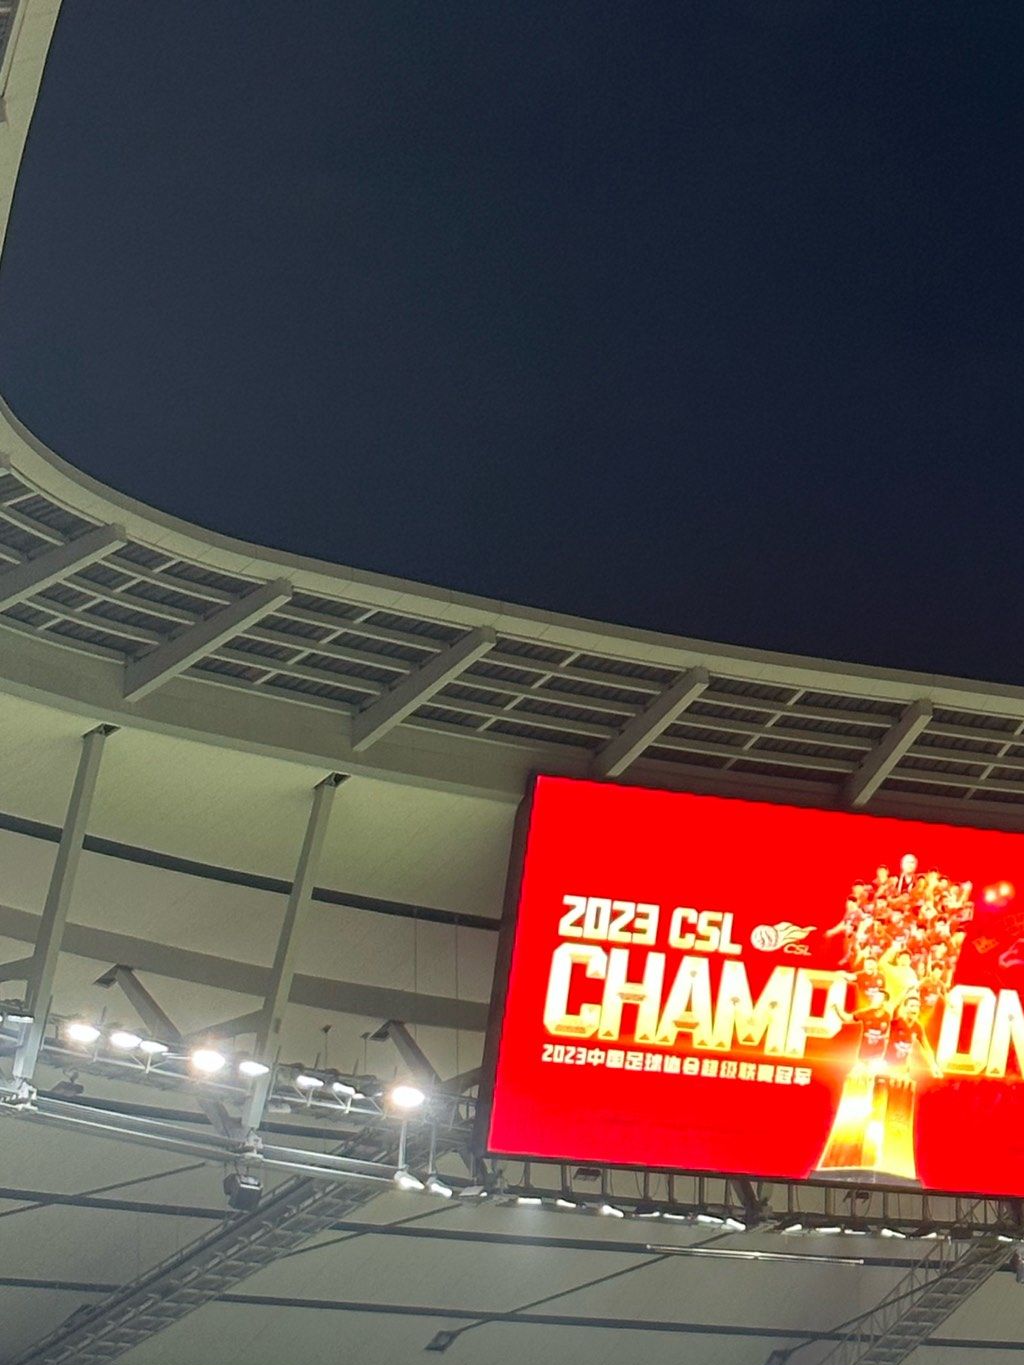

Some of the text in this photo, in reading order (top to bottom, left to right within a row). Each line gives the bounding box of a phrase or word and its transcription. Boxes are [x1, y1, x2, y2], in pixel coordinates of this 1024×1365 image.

[558, 894, 743, 955] 2023 CSL
[783, 943, 812, 956] CSL
